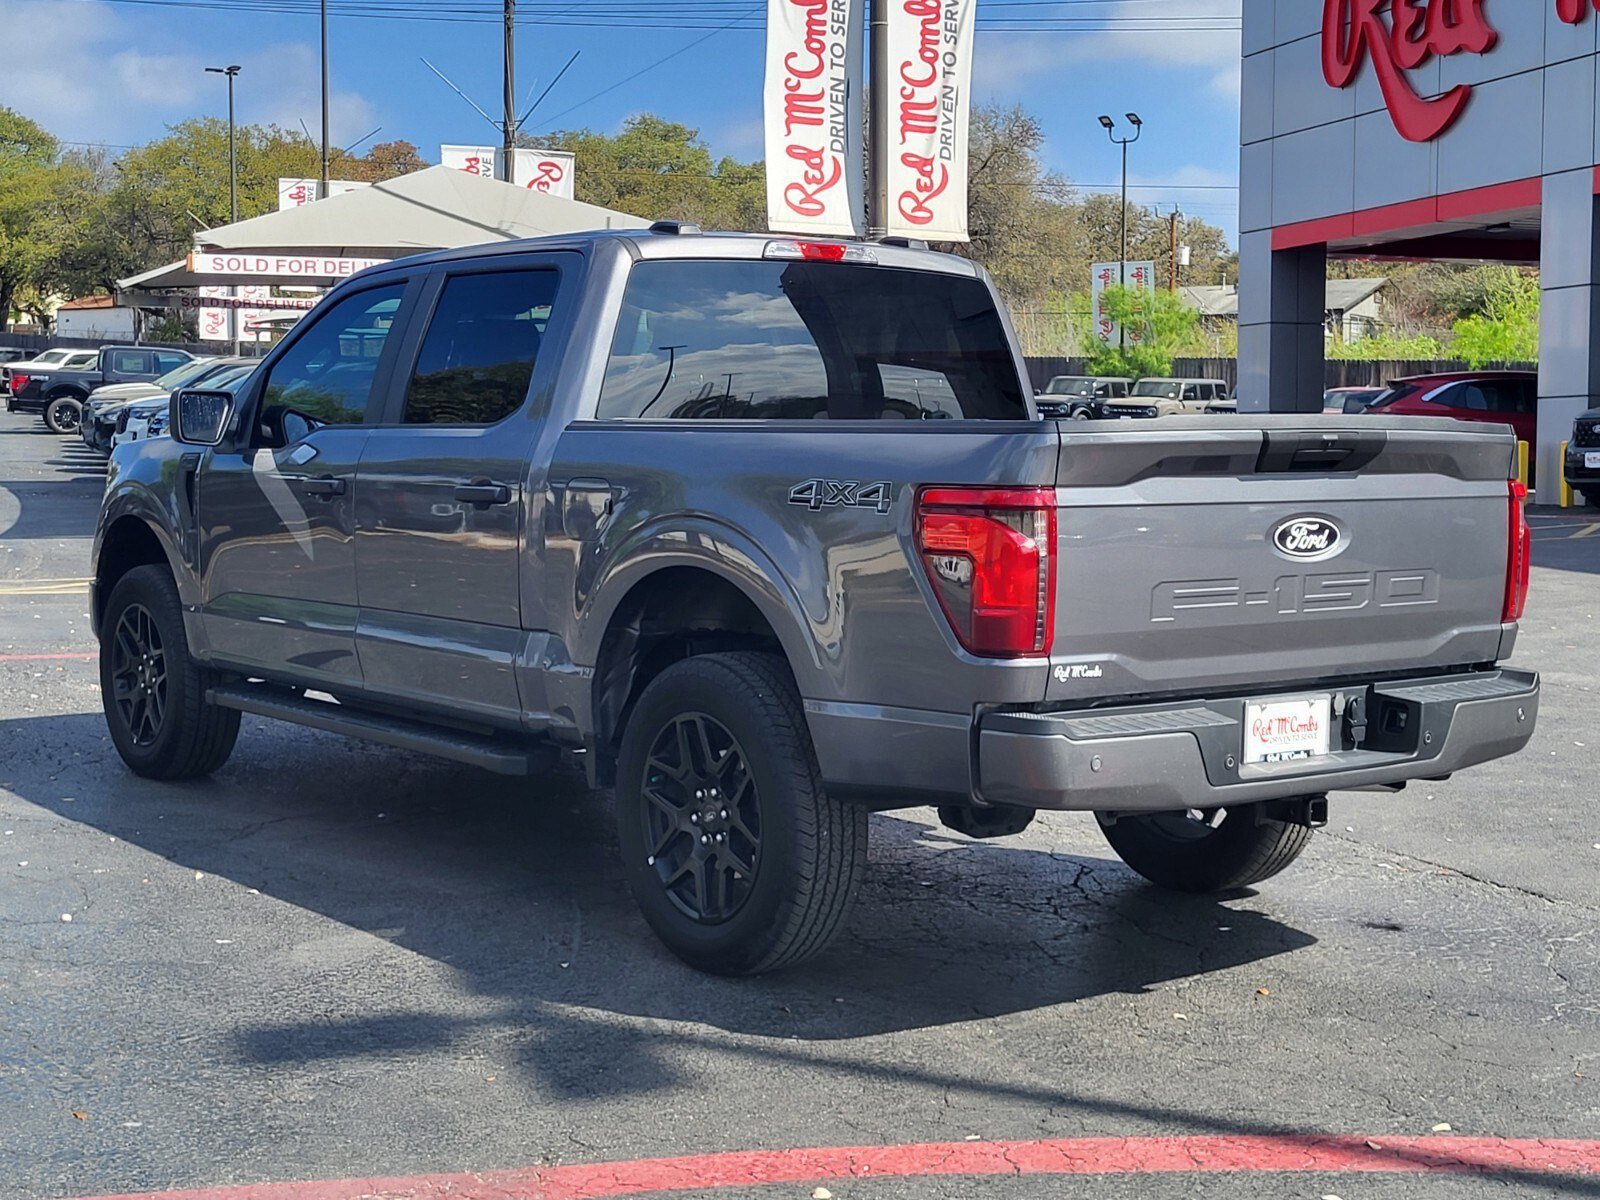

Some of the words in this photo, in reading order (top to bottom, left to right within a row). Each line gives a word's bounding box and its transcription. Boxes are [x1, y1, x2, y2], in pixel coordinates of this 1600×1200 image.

[830, 42, 847, 70] TO
[942, 52, 958, 79] TO
[830, 78, 846, 154] DRIVEN
[940, 86, 955, 161] DRIVEN
[527, 161, 563, 193] Re
[784, 145, 841, 216] Red
[898, 153, 948, 225] Red
[212, 257, 269, 272] SOLD
[275, 259, 317, 273] FOR
[181, 297, 219, 308] SOLD
[224, 299, 252, 309] FOR
[1286, 523, 1330, 550] Ford
[1151, 568, 1440, 622] F-150
[1054, 665, 1070, 683] Red
[1253, 719, 1273, 743] Red
[1275, 715, 1318, 734] McCombs
